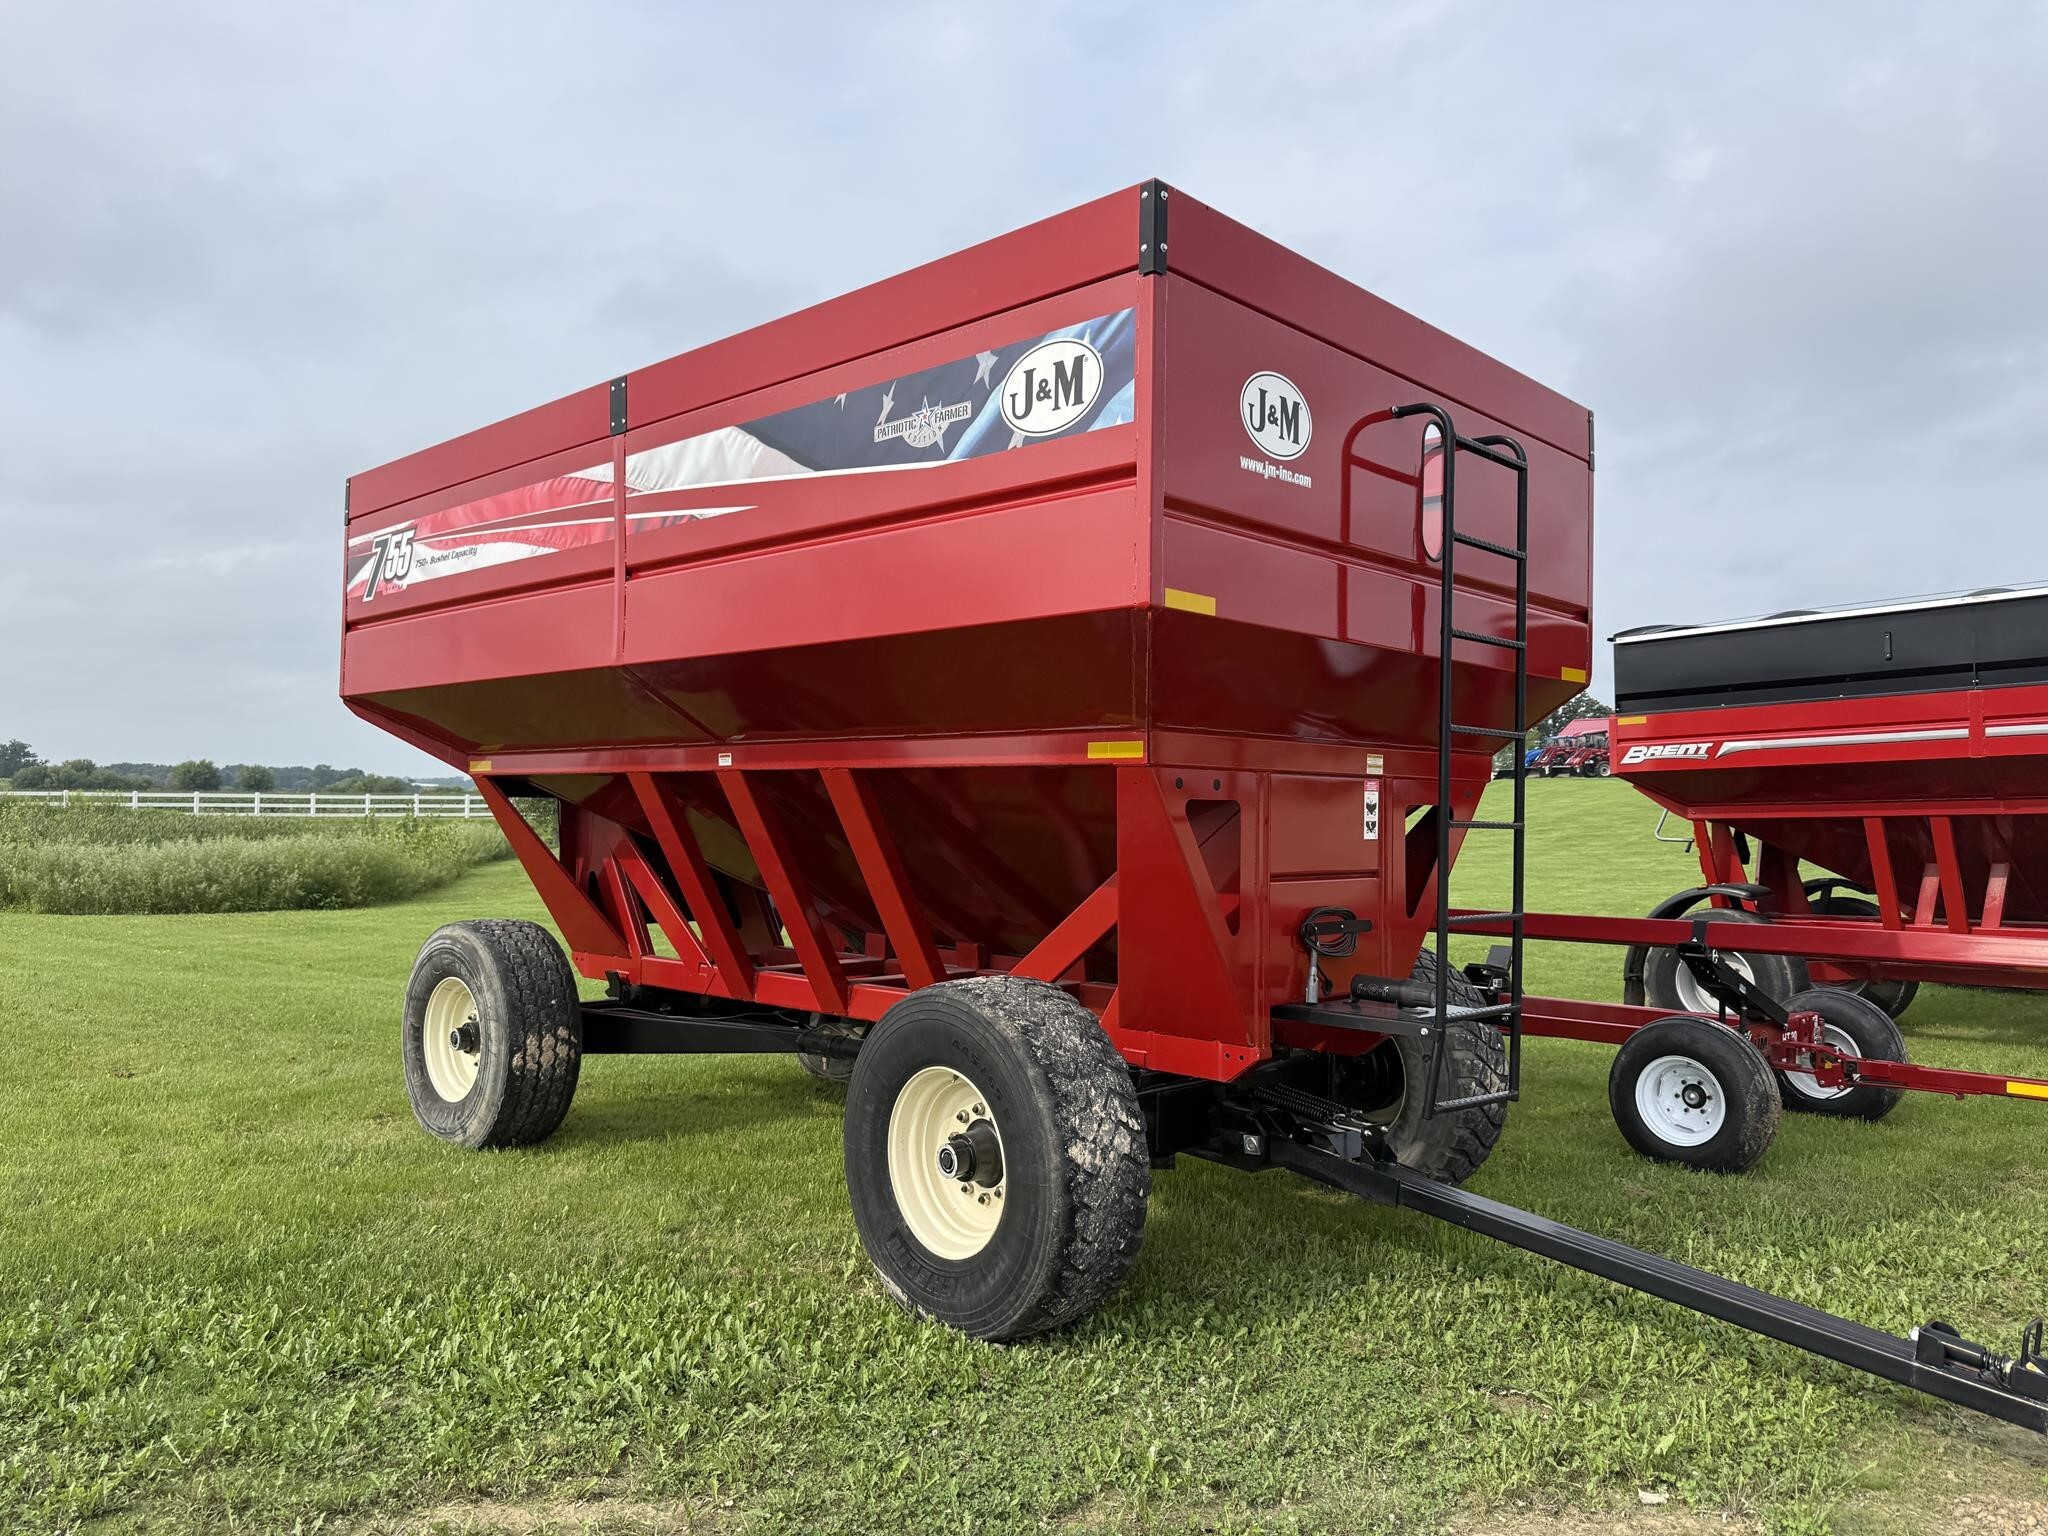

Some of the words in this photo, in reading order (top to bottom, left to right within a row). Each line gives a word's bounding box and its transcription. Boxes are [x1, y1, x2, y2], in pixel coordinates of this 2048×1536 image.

[1010, 354, 1086, 420] J&M
[877, 419, 917, 439] PATRIOTIC
[934, 405, 968, 423] FARMER
[1248, 388, 1301, 445] J&M
[1240, 456, 1312, 488] www.jm-inc.com
[363, 529, 417, 602] 755
[430, 551, 450, 563] Bushel
[450, 546, 478, 561] Capacity
[1620, 742, 1714, 764] BRENT
